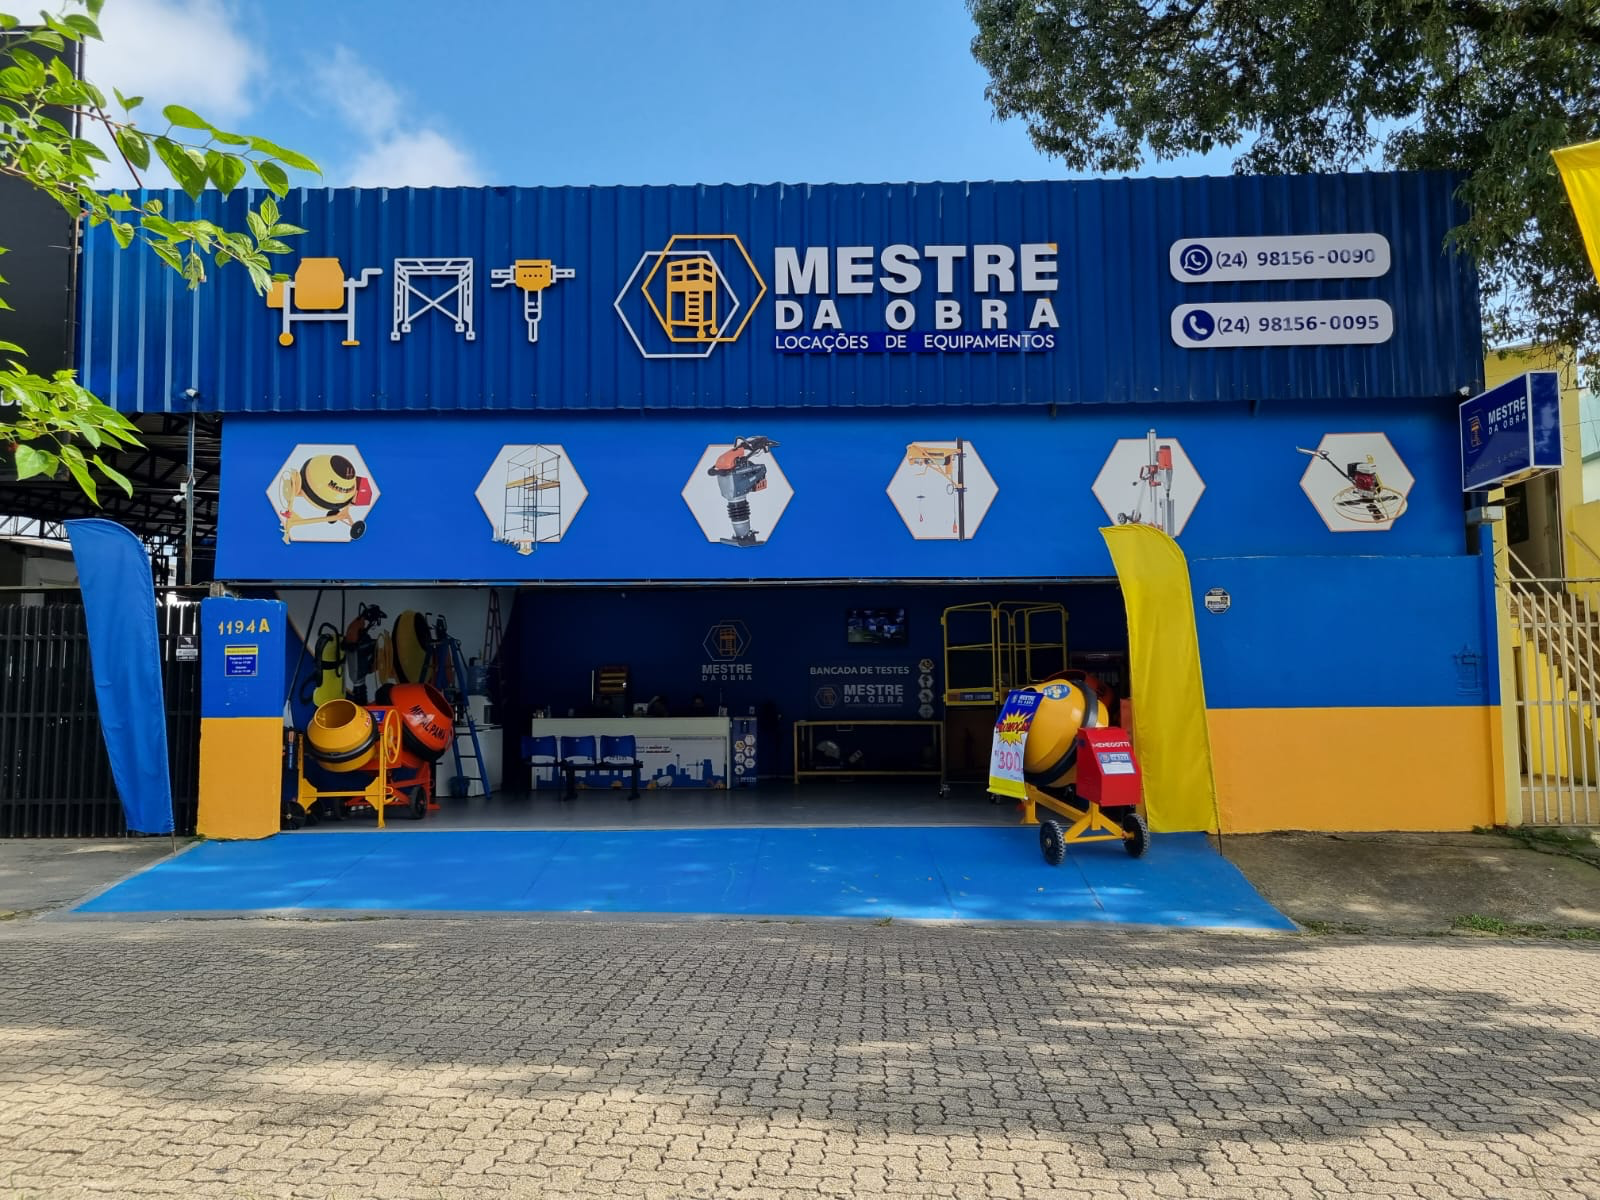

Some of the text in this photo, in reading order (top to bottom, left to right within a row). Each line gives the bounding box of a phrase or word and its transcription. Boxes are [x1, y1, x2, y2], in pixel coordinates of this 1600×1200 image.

[774, 242, 1059, 295] MESTRE
[1216, 248, 1376, 269] (24) 98156-0090
[775, 298, 1060, 331] DA OBRA
[1217, 314, 1379, 335] (24) 98156-0095
[775, 332, 1055, 353] LOCAÇÕES DE EQUIPAMENTOS
[1488, 396, 1526, 425] MESTRE
[1488, 413, 1527, 436] DA OBRA
[702, 663, 753, 674] MESTRE
[809, 666, 910, 675] BANCADA DE TESTES
[843, 684, 904, 696] MESTRE
[843, 695, 904, 704] DA OBRA
